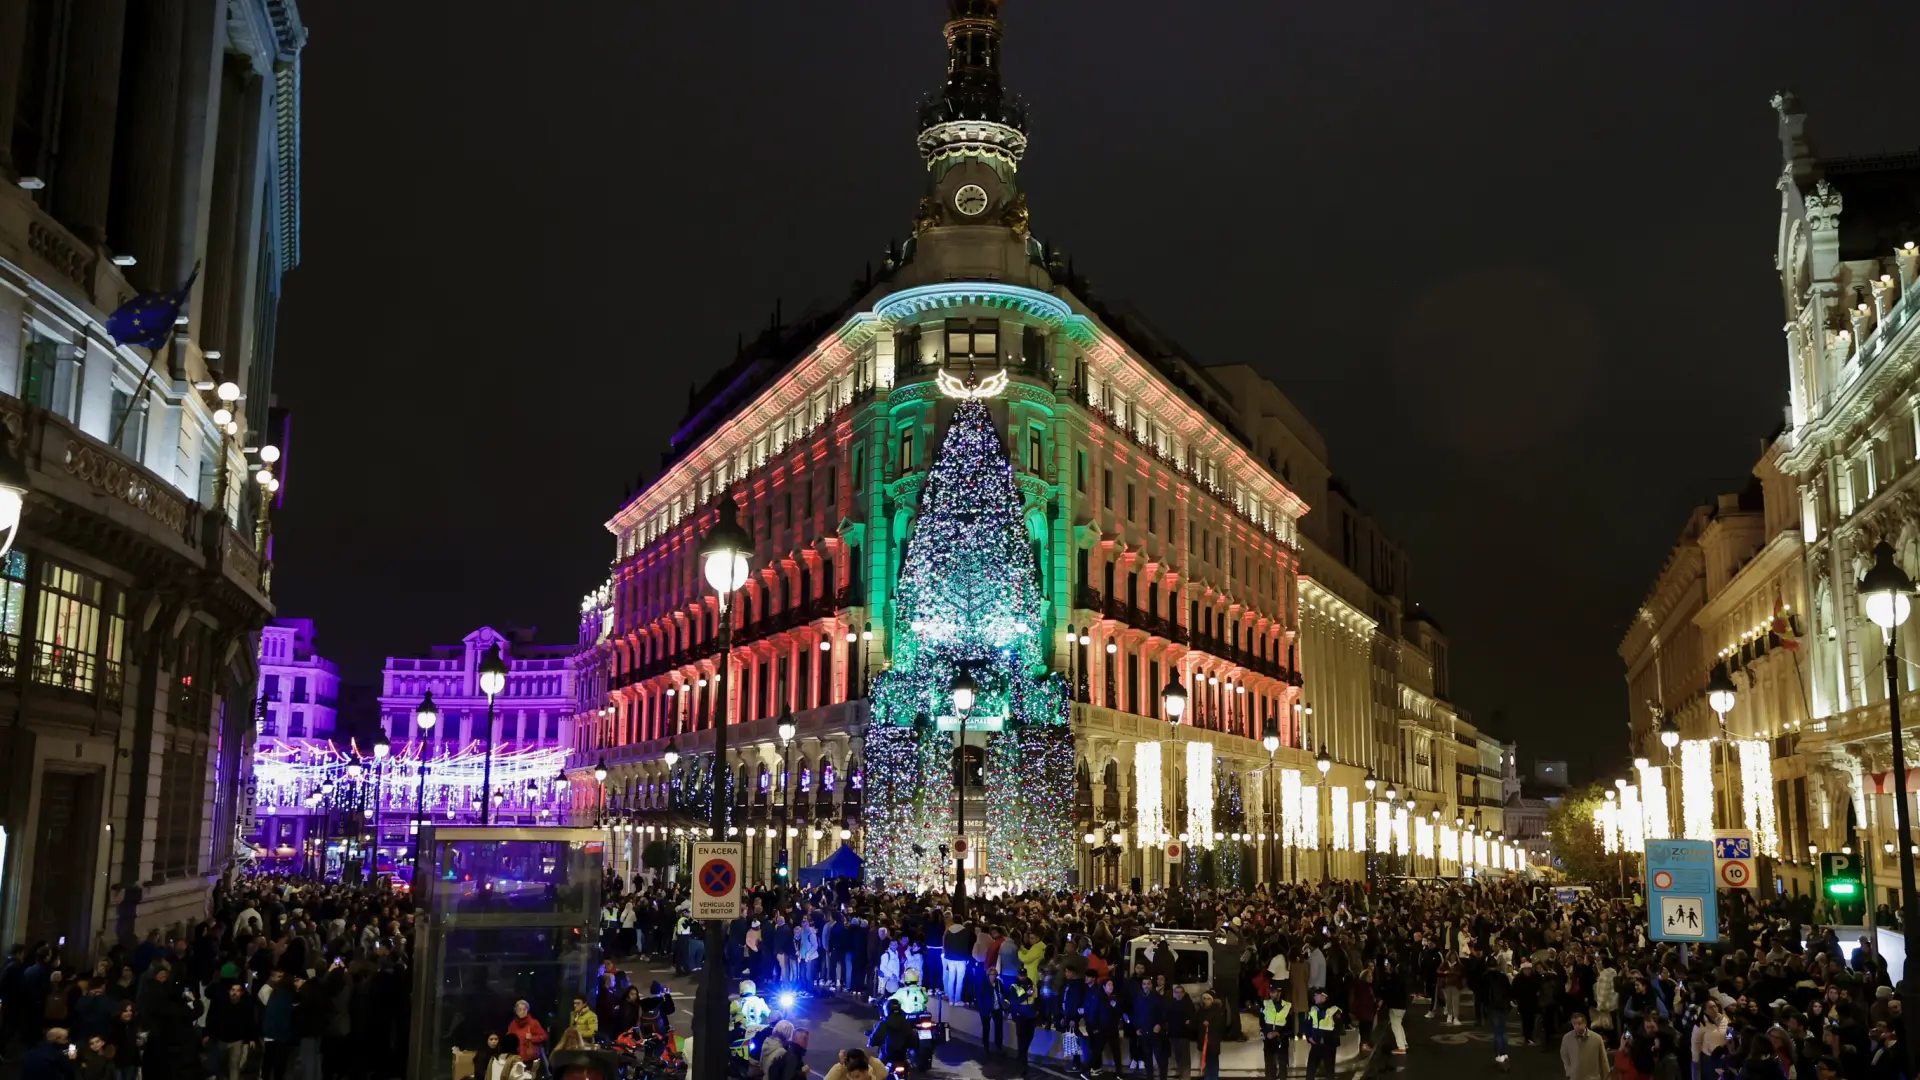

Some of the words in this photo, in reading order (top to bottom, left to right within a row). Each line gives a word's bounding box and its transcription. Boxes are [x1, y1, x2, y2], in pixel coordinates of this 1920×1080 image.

[245, 776, 256, 826] HOTEL
[1730, 869, 1742, 878] 10
[1831, 855, 1849, 876] P
